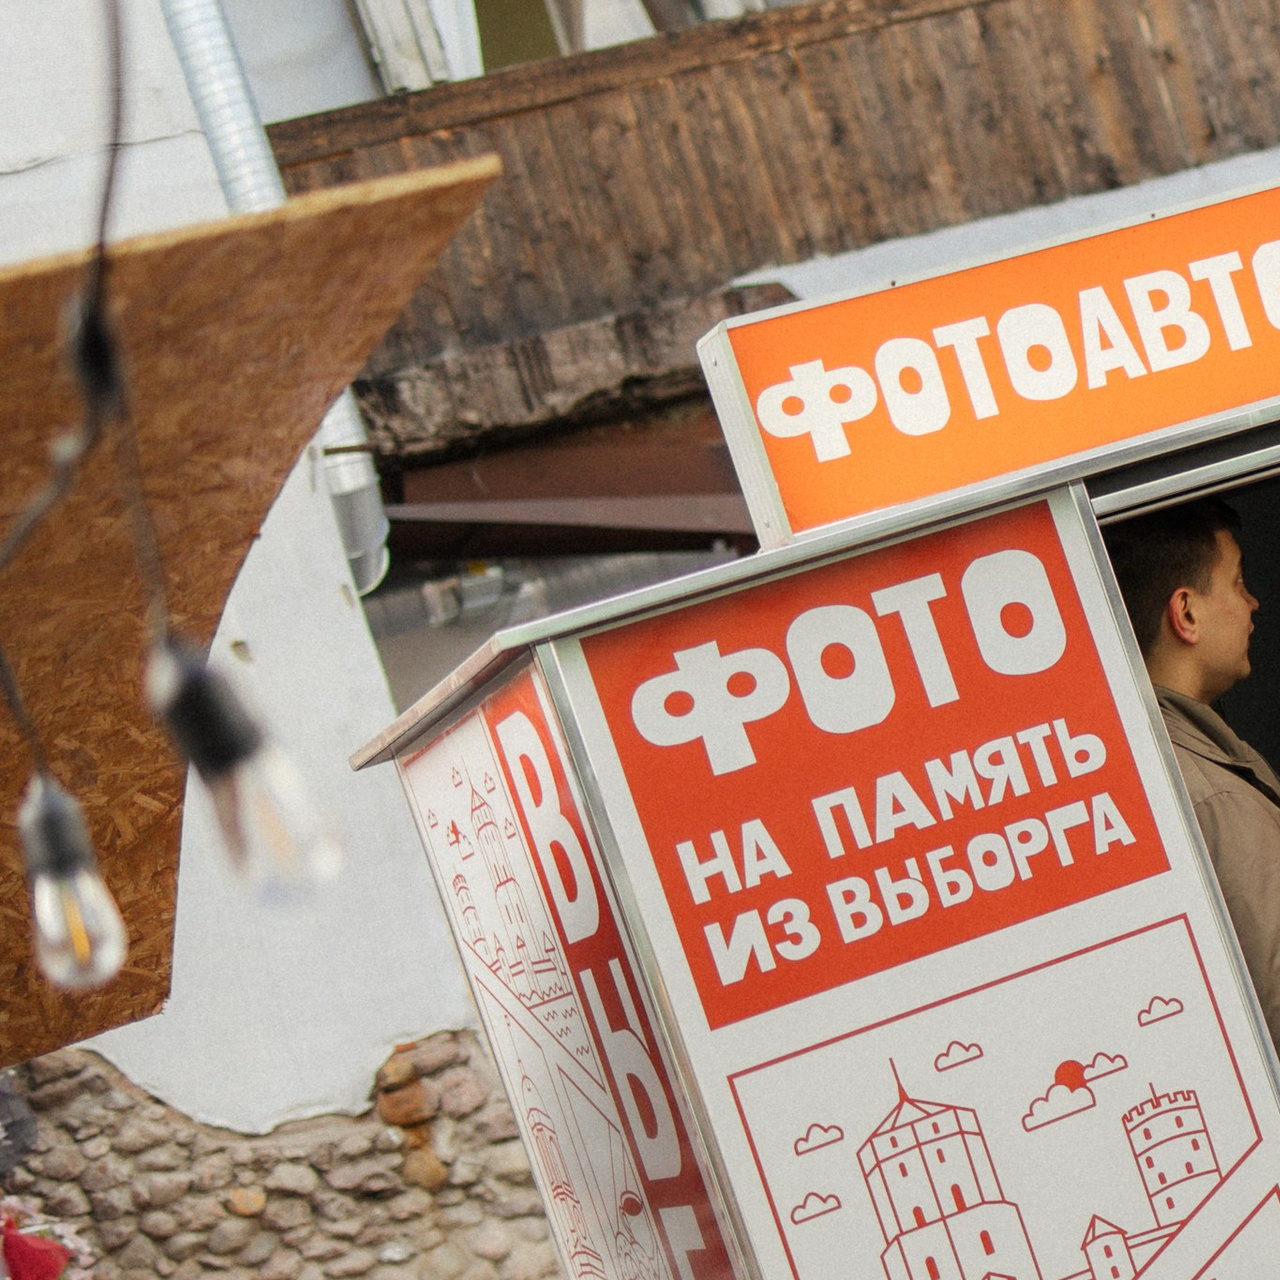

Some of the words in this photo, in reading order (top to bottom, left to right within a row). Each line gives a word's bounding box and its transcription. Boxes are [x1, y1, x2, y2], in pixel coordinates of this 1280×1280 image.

[631, 549, 1067, 776] ФОТО
[676, 819, 792, 905] НА
[811, 717, 1108, 859] ПАМЯТЬ
[703, 898, 822, 986] ИЗ
[826, 791, 1137, 944] ВЫБОРГА
